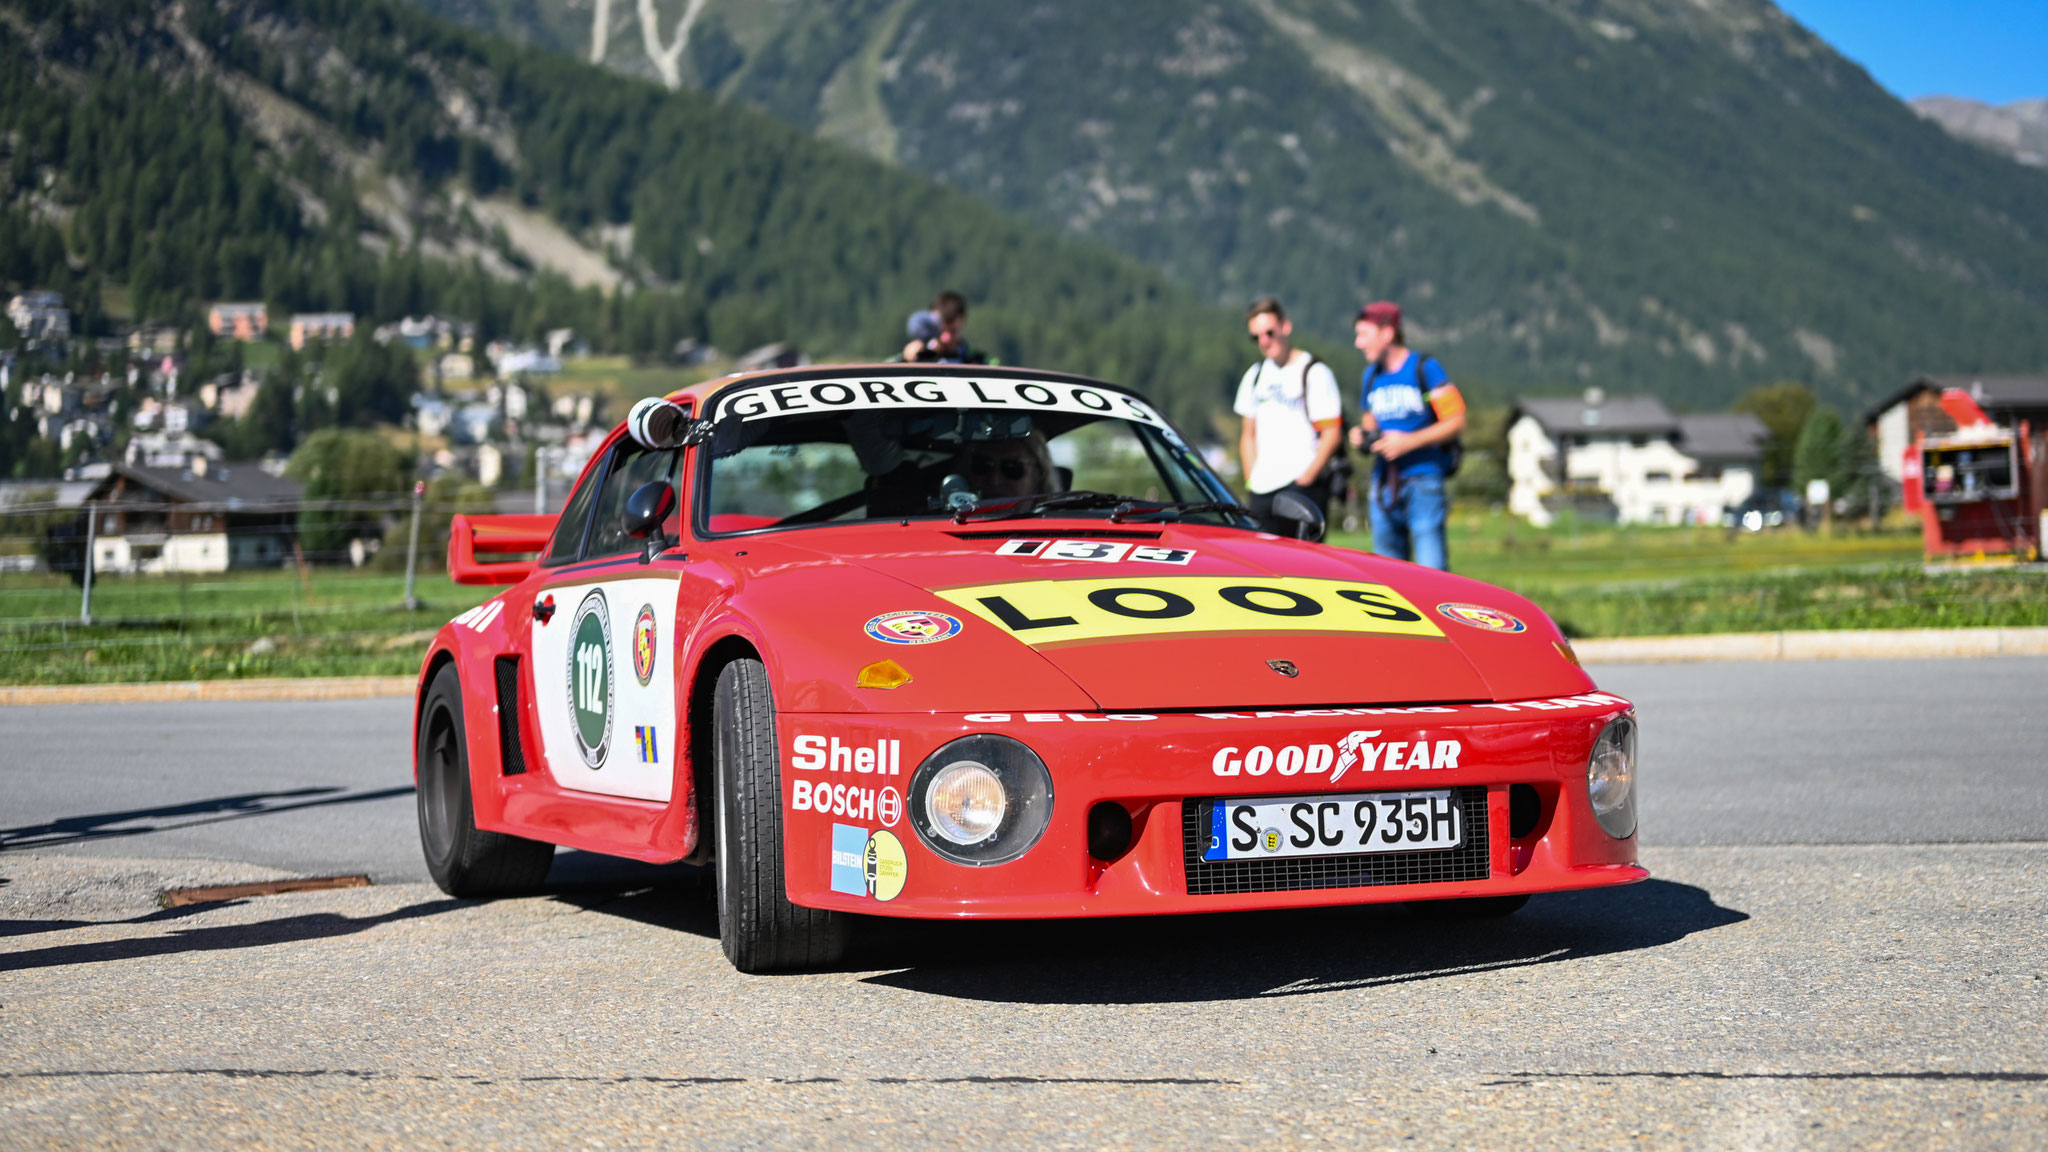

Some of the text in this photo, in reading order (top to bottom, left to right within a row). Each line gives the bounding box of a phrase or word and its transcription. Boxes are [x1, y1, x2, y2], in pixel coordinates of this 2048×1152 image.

[725, 380, 1153, 421] GEORG LOOS
[977, 585, 1422, 631] LOOS
[577, 641, 603, 715] 112
[963, 713, 1158, 722] GELO
[1471, 694, 1630, 711] TEAM
[792, 735, 900, 775] Shell
[792, 780, 875, 820] BOSCH
[1231, 804, 1258, 851] S
[1290, 802, 1344, 848] SC
[1354, 796, 1456, 845] 935H
[832, 850, 863, 869] BILSTEIN
